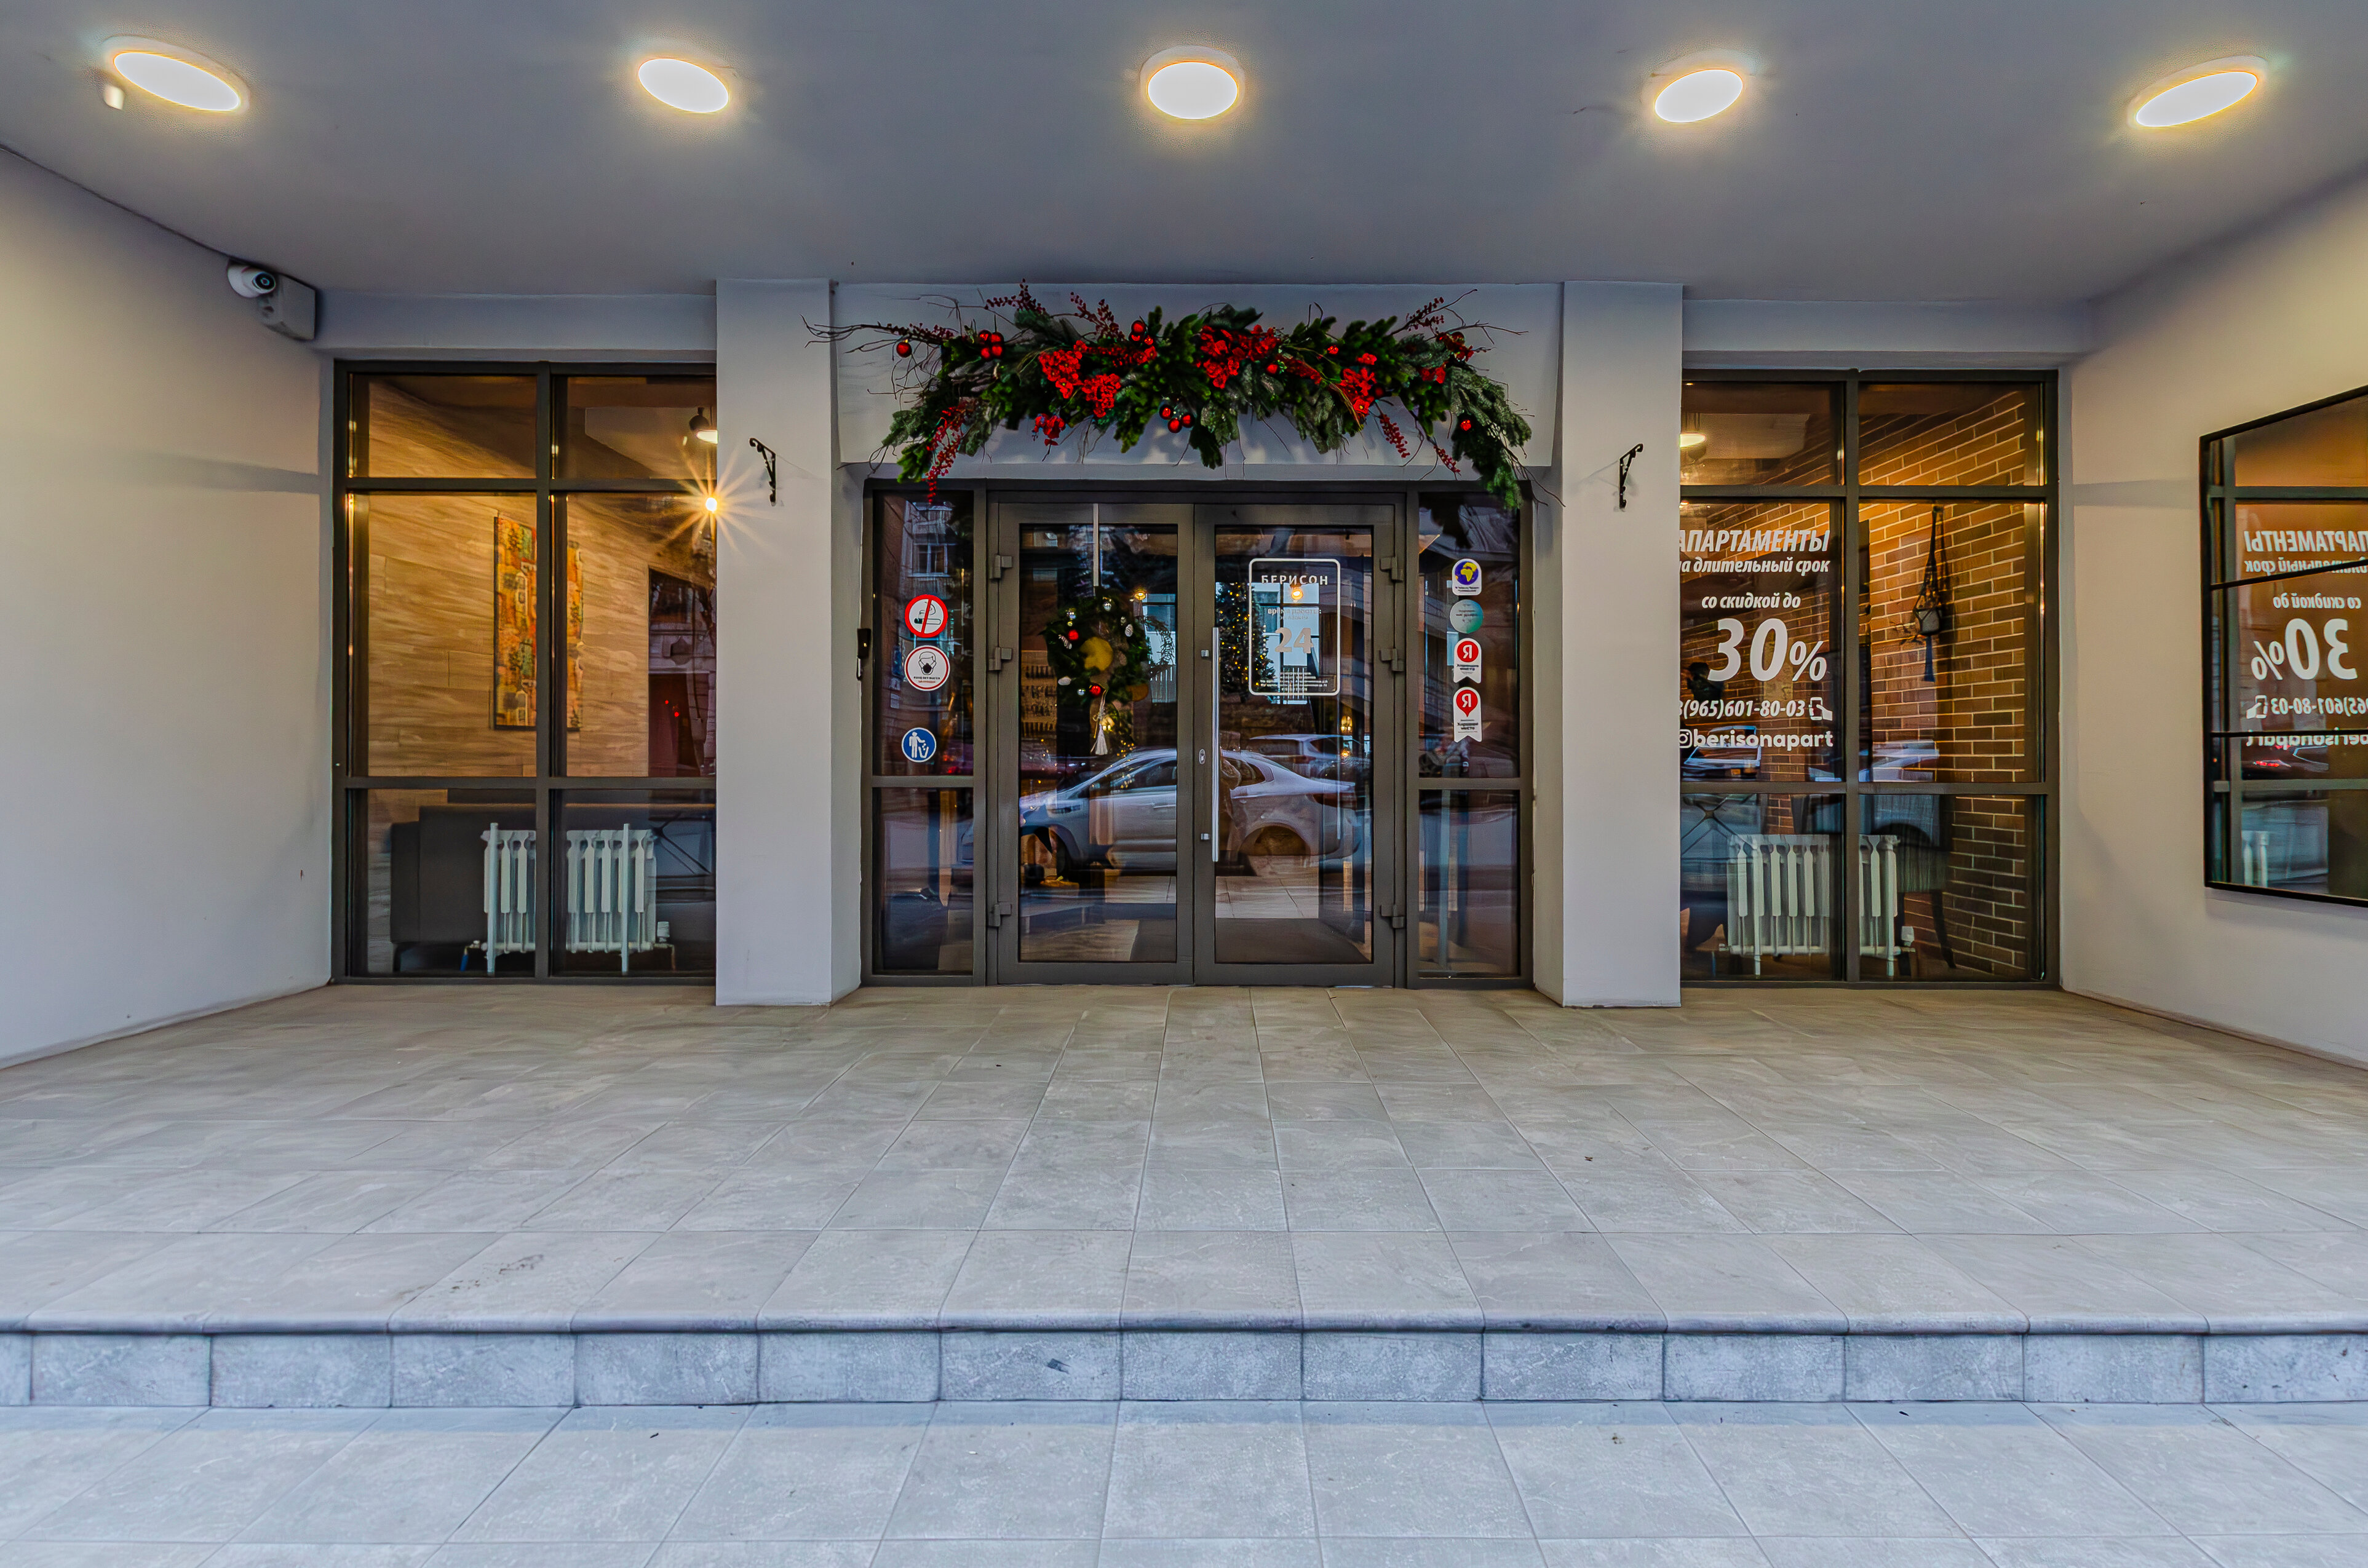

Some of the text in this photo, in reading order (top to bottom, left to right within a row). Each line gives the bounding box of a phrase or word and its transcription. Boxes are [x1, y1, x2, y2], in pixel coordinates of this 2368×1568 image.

[1680, 556, 1830, 577] а длительный срок
[1261, 574, 1328, 585] БЕРИСОН
[1701, 592, 1802, 609] со скидкой до
[1274, 627, 1314, 654] 24
[1707, 617, 1827, 682] 30%
[1693, 728, 1834, 751] berisonapart
